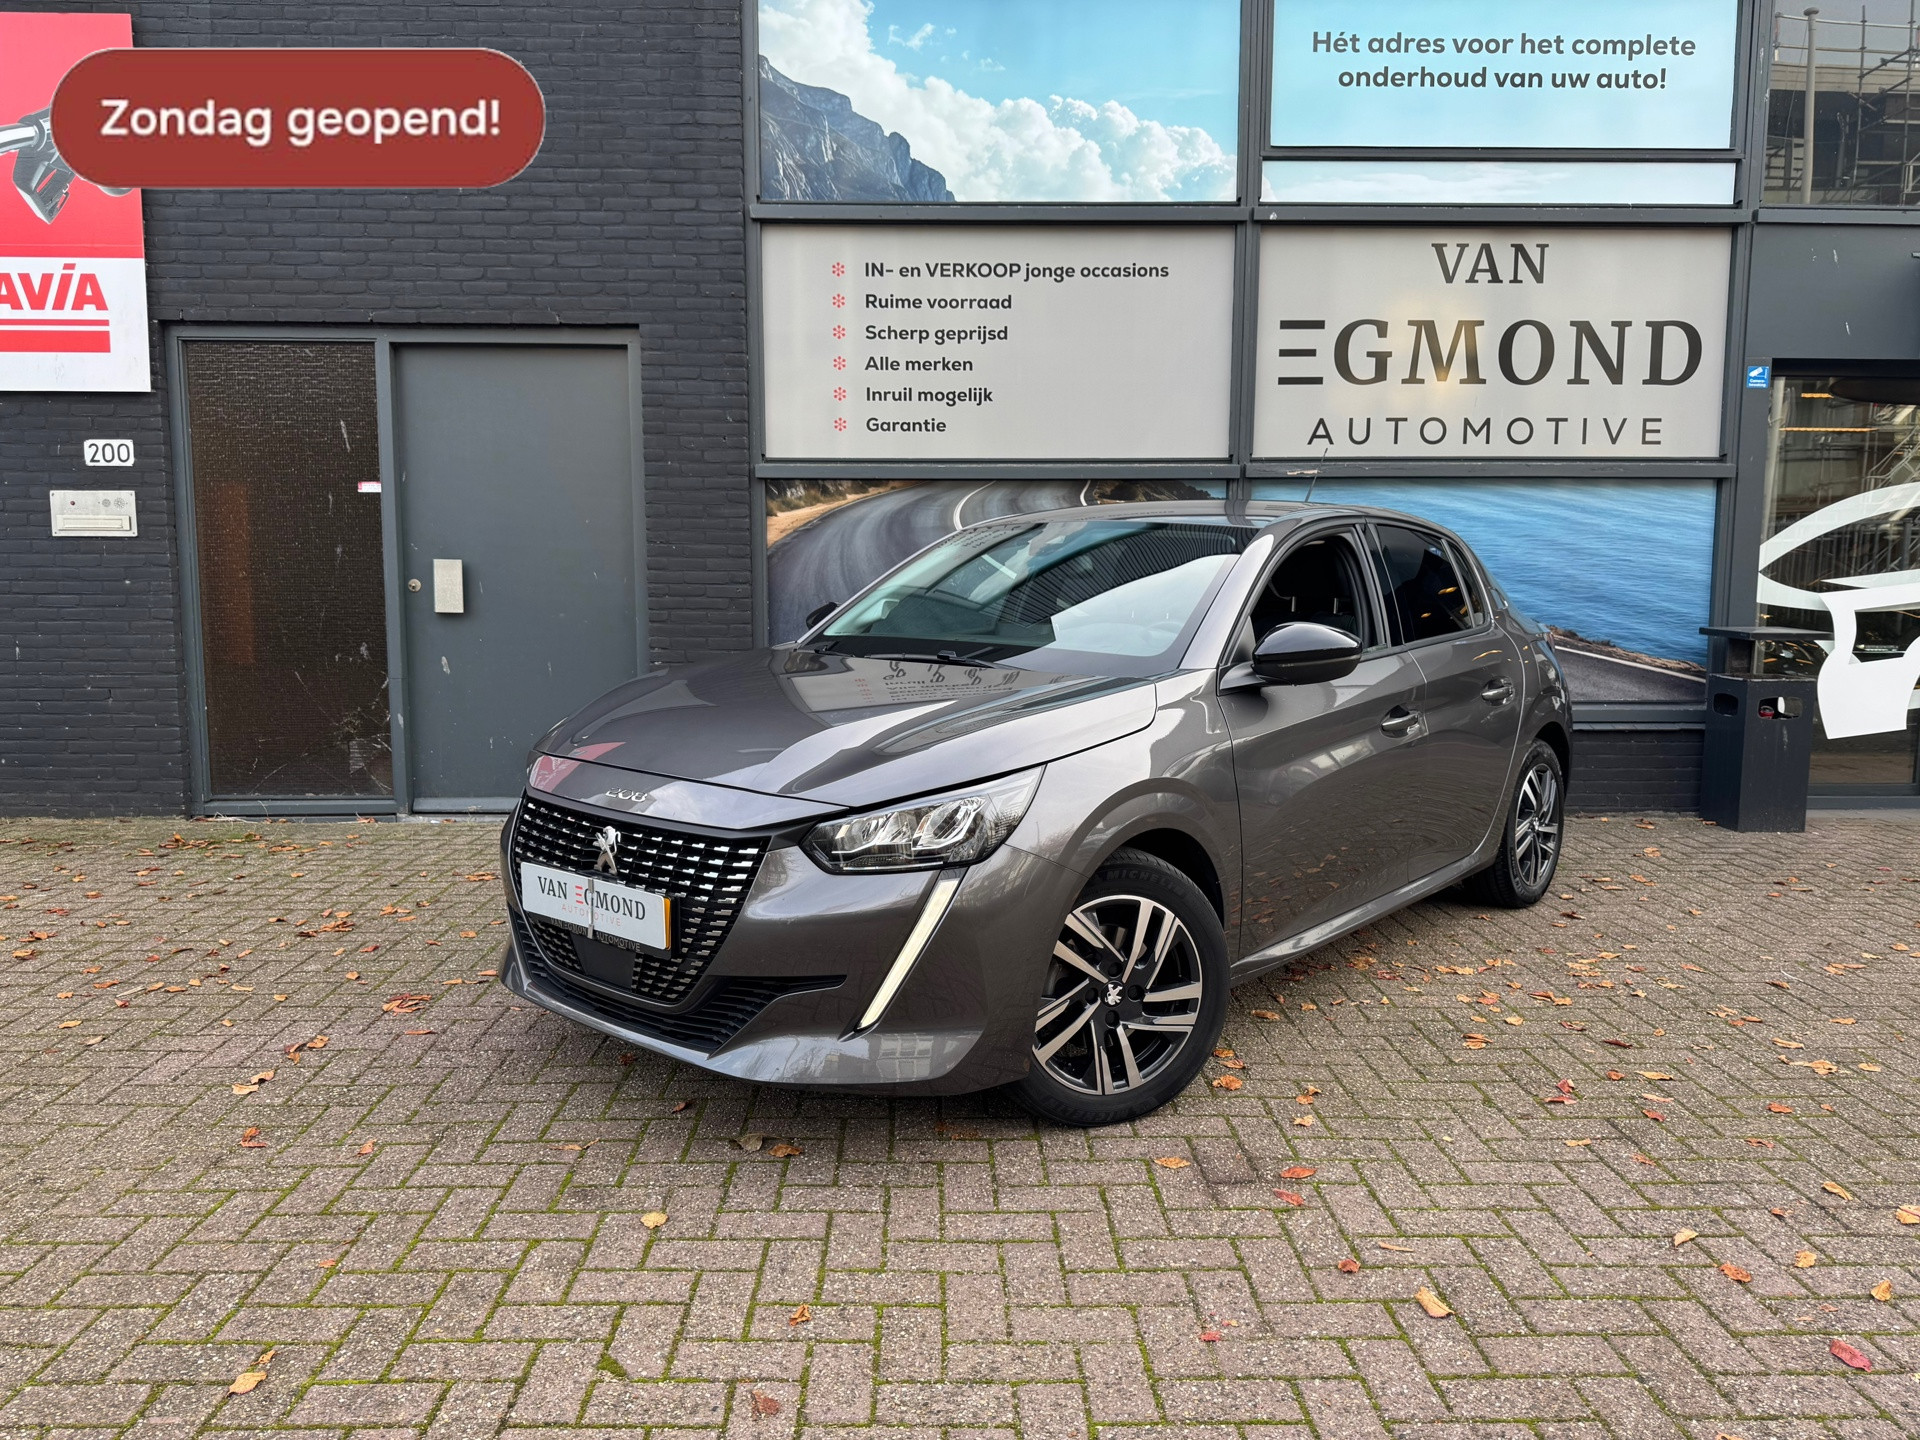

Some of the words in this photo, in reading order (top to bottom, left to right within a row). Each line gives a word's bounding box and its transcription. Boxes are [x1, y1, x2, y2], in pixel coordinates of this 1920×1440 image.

[1313, 31, 1360, 53] Hét
[1368, 32, 1445, 54] adres
[1452, 38, 1514, 54] voor
[1520, 32, 1564, 55] het
[1571, 33, 1697, 62] complete
[1338, 66, 1487, 88] onderhoud
[1494, 72, 1543, 88] van
[1551, 73, 1591, 89] uw
[1596, 68, 1667, 90] auto!
[865, 262, 894, 277] IN-
[898, 266, 921, 278] en
[925, 262, 1022, 278] VERKOOP
[1023, 262, 1076, 283] jonge
[1080, 262, 1170, 278] occasions
[1431, 242, 1550, 284] VAN
[865, 293, 923, 309] Ruime
[926, 294, 1012, 310] voorraad
[865, 324, 930, 344] Scherp
[934, 325, 1009, 346] geprijsd
[1277, 318, 1703, 386] EGMOND
[864, 356, 901, 371] Alle
[905, 356, 973, 372] merken
[866, 386, 913, 402] Inruil
[917, 387, 993, 407] mogelijk
[866, 417, 947, 433] Garantie
[1307, 416, 1662, 446] AUTOMOTIVE
[88, 443, 131, 463] 200
[605, 787, 648, 803] 208
[537, 875, 568, 900] VAN
[564, 922, 588, 935] EGMON
